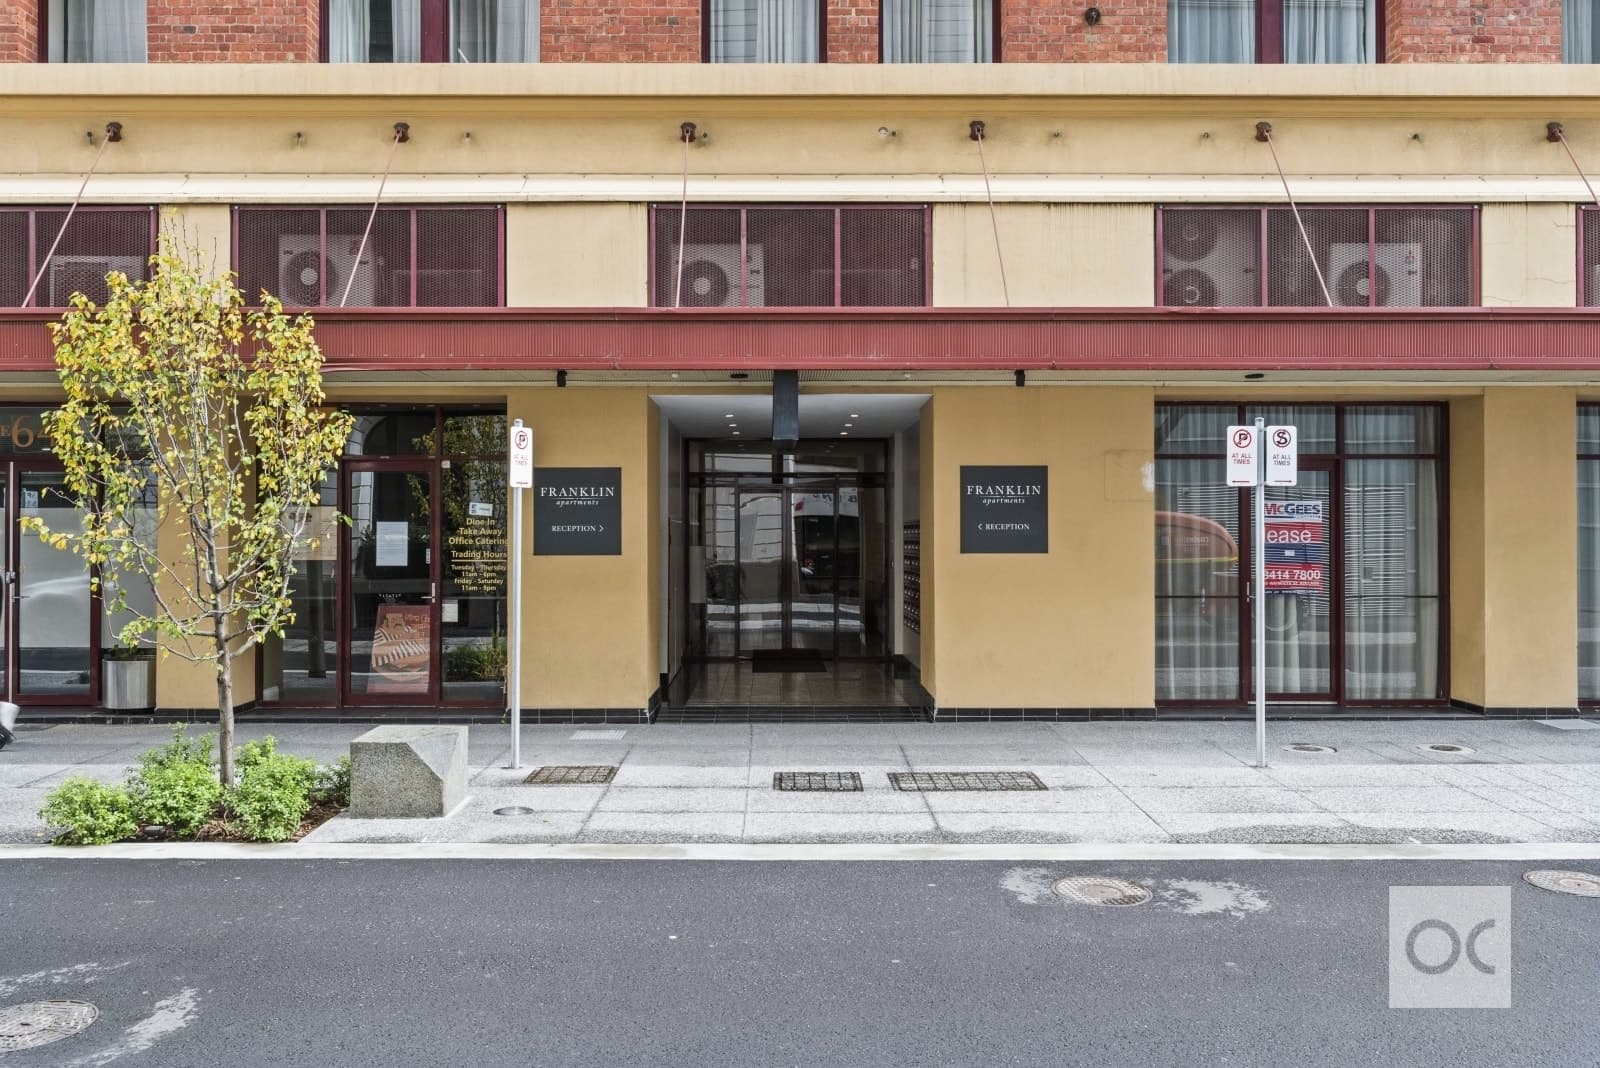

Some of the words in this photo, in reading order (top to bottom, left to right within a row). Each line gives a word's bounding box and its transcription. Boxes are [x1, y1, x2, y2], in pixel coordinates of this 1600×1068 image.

[541, 487, 615, 497] FRANKLIN
[967, 485, 1041, 495] FRANKLIN
[555, 500, 599, 508] apartments
[982, 498, 1025, 506] apartments
[985, 523, 1031, 531] RECEPTION
[480, 528, 502, 537] Away
[448, 537, 474, 545] Office
[451, 550, 481, 560] Trading
[483, 550, 507, 558] Hours
[451, 564, 475, 572] Tuesday
[480, 564, 506, 572] Thursday
[1293, 570, 1321, 580] 7800
